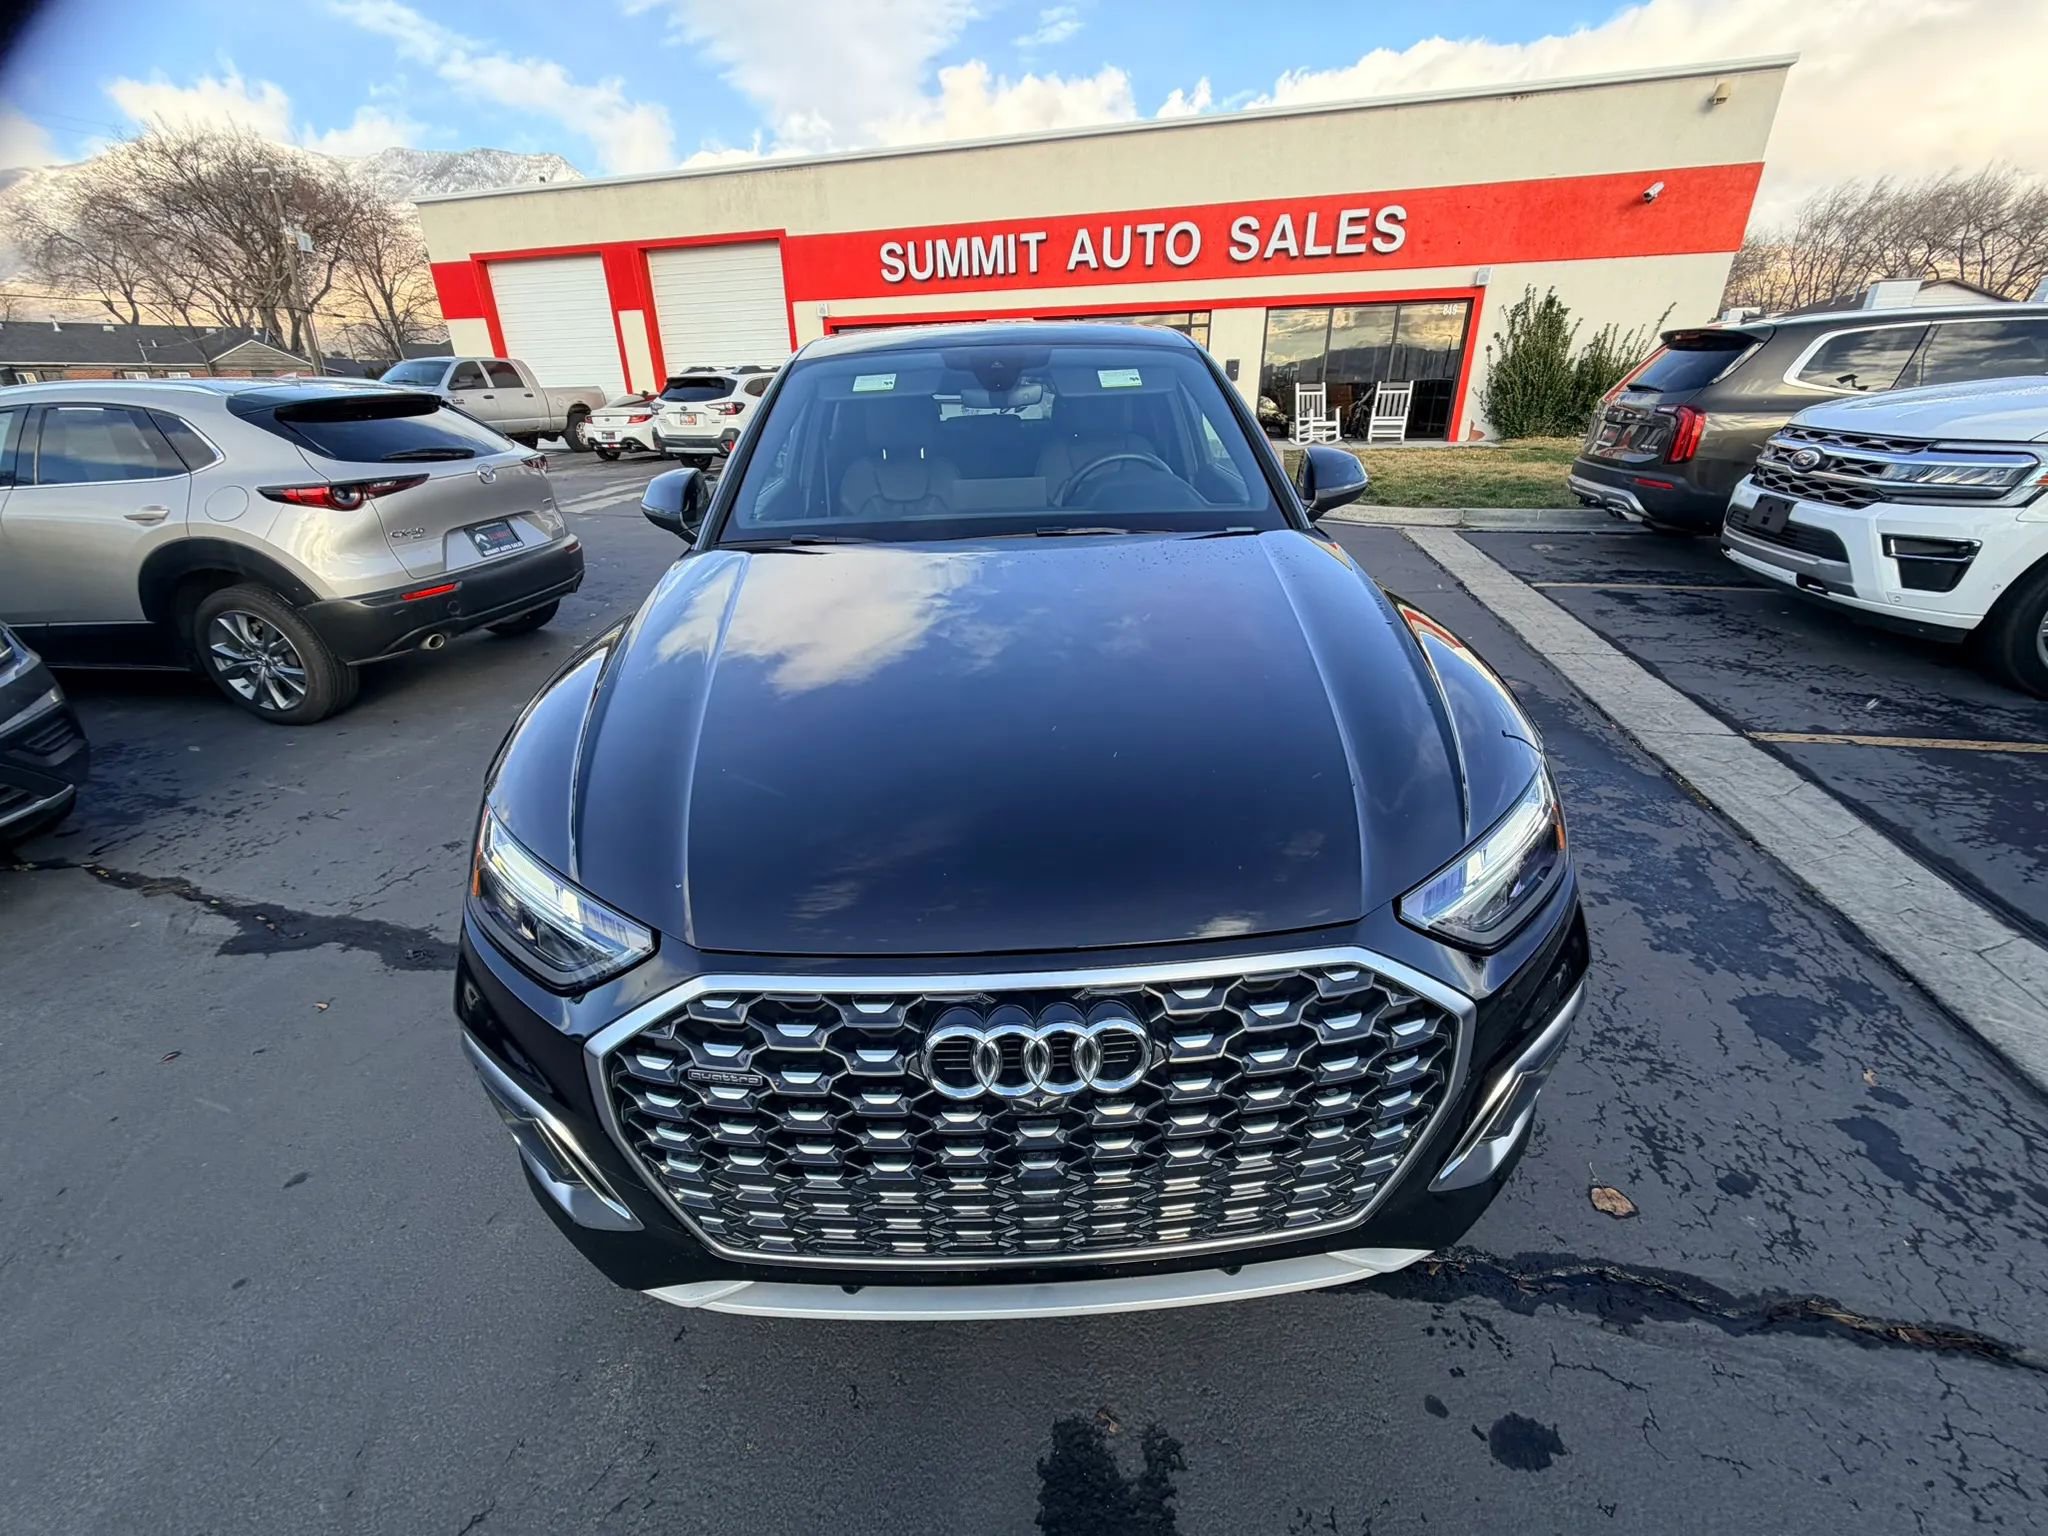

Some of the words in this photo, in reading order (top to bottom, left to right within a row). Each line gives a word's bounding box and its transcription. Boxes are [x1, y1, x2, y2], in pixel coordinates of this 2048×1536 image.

[880, 232, 1046, 282] SUMMIT
[1067, 221, 1201, 271] AUTO
[1229, 204, 1407, 262] SALES
[690, 1071, 759, 1084] quattro
